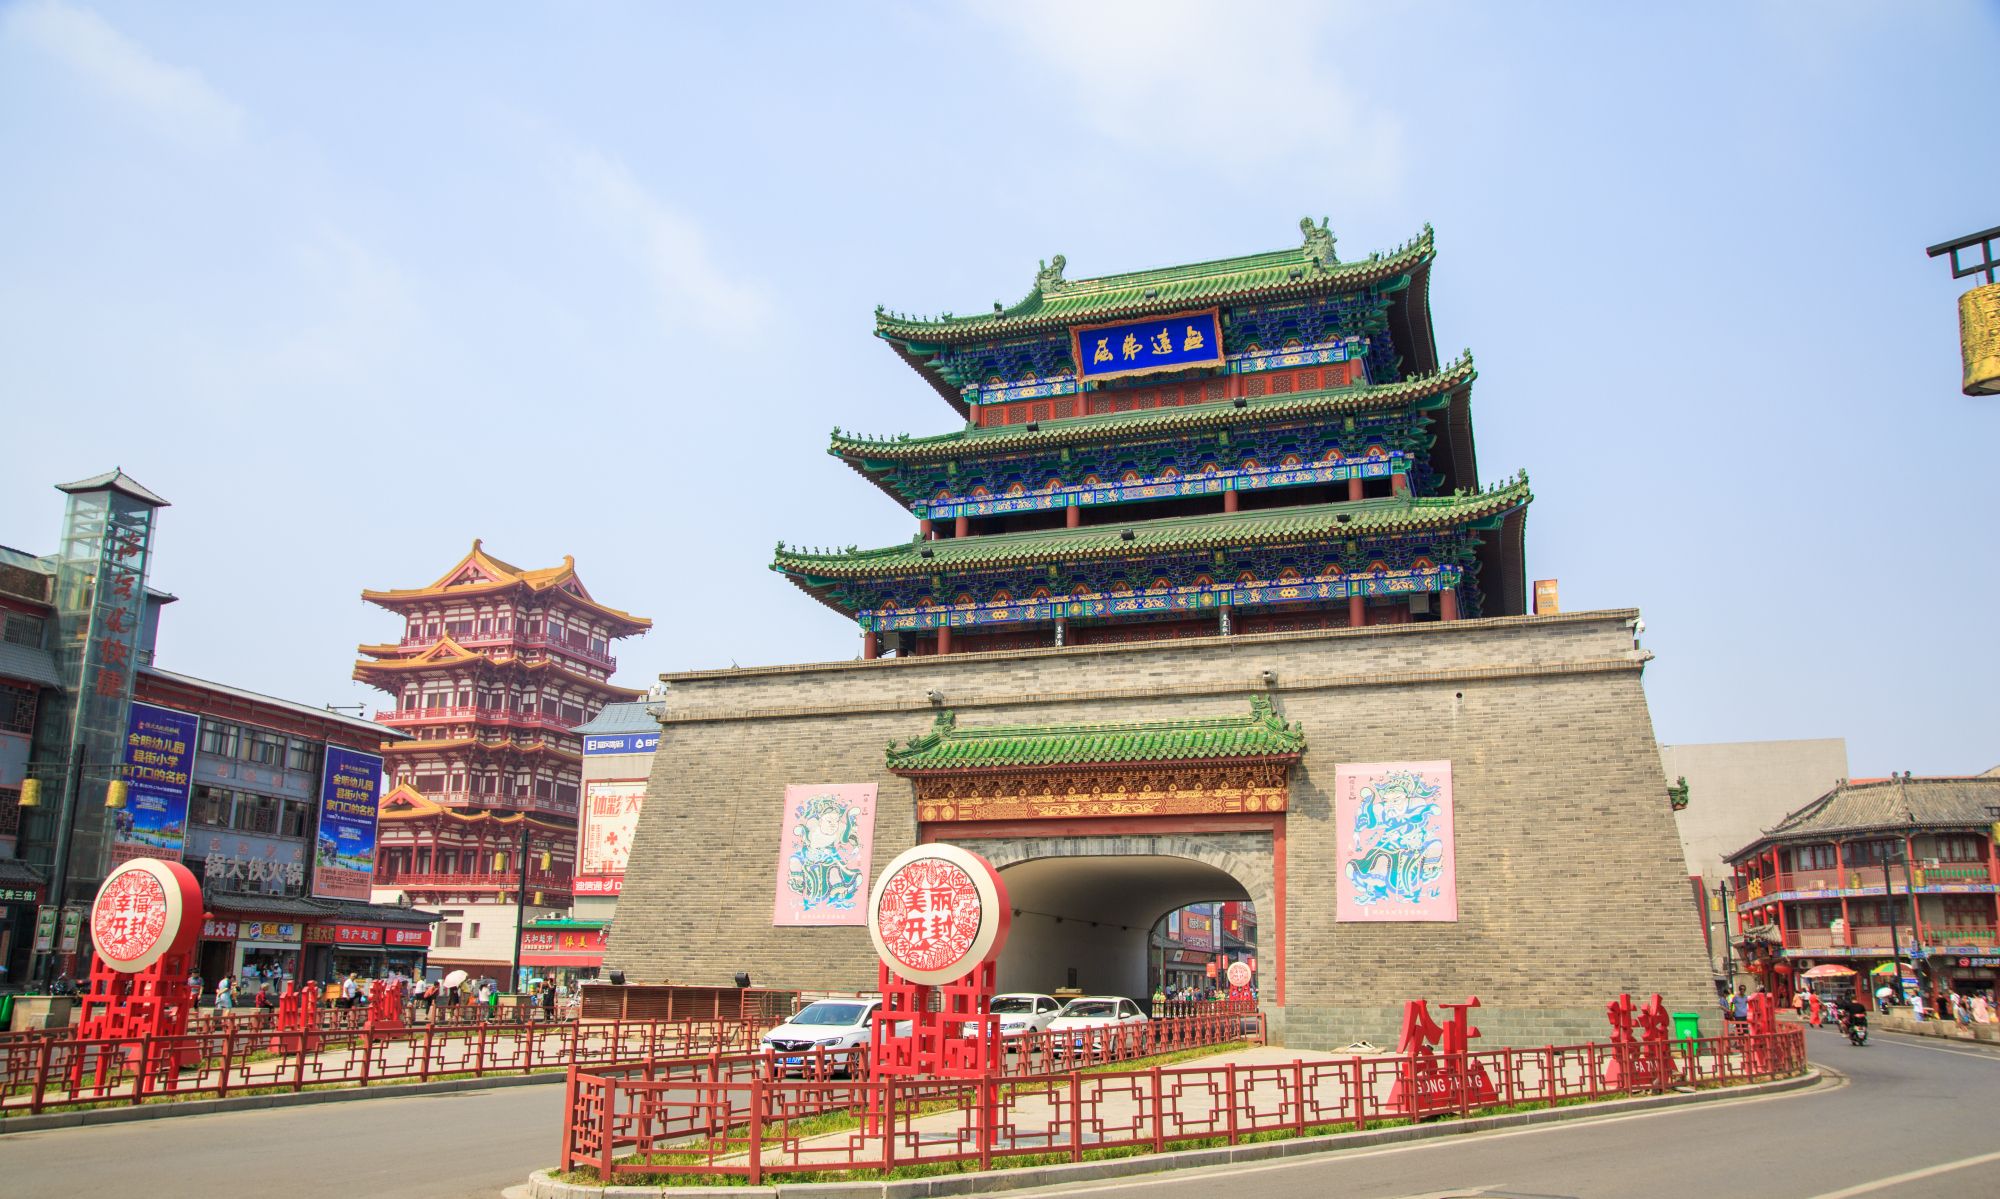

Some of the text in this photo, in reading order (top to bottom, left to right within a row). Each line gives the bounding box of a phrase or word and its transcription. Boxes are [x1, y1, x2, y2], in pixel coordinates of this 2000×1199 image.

[205, 852, 304, 886] 锅大侠火锅
[575, 880, 603, 891] 迪信通
[115, 893, 152, 914] 幸福
[905, 887, 953, 912] 美丽
[110, 916, 147, 939] 开封
[204, 921, 237, 937] 锅大侠
[341, 928, 379, 941] 特产超市
[904, 916, 954, 941] 开封
[524, 933, 554, 944] 天和超市
[1447, 1073, 1483, 1090] ZHNG
